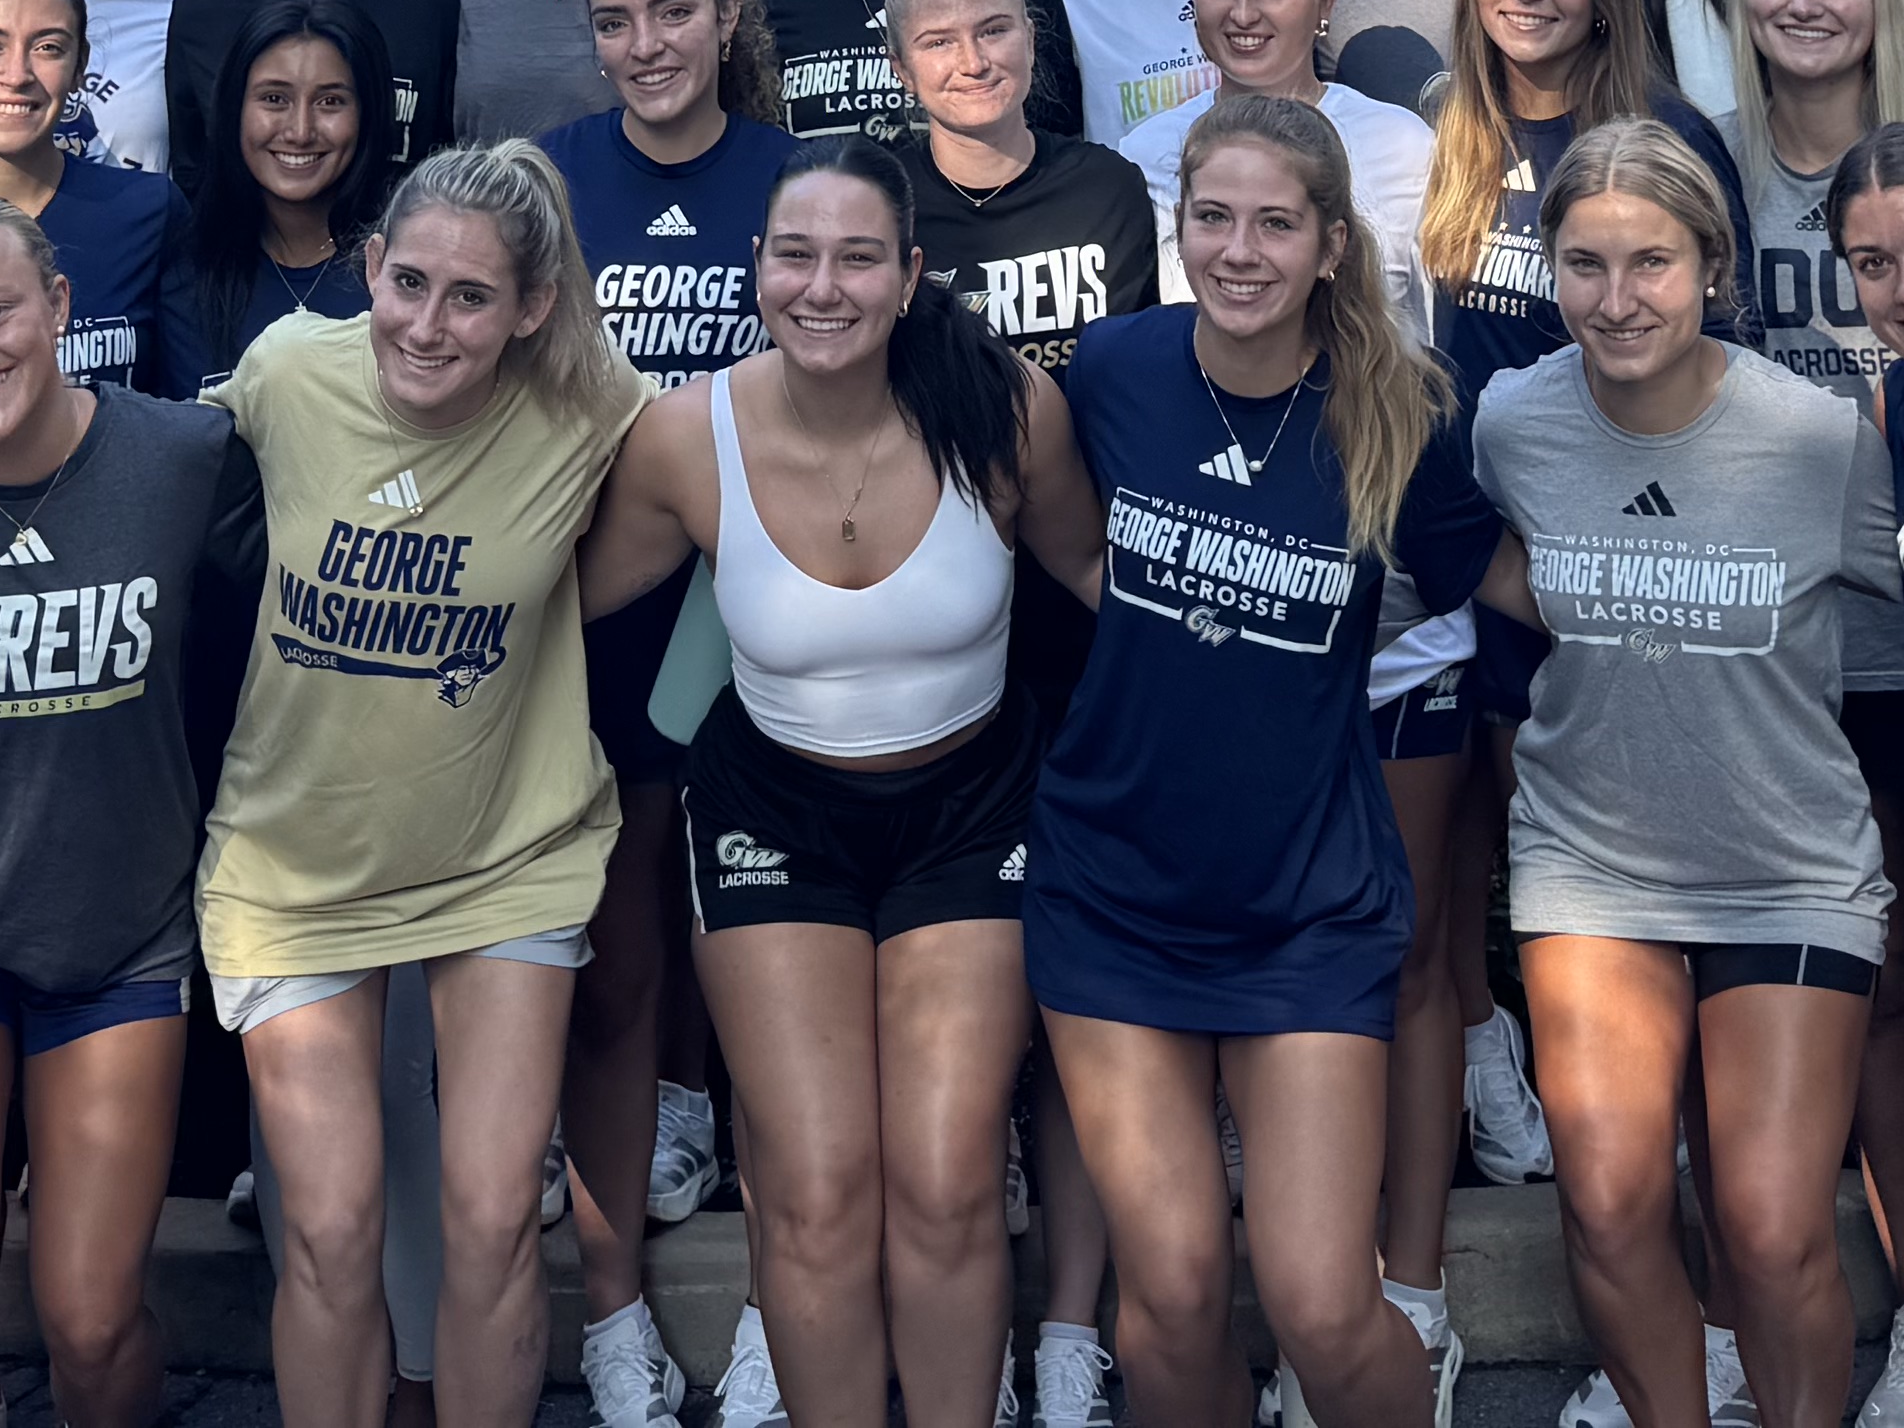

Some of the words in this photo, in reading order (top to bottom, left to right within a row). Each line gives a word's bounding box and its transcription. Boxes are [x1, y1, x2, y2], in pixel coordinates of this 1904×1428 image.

[781, 59, 853, 101] GEORGE
[1142, 56, 1194, 75] GEORGE
[646, 224, 697, 236] adidas
[595, 264, 746, 309] GEORGE
[977, 243, 1107, 337] REVS
[73, 317, 94, 329] DC
[1150, 496, 1276, 543] WASHINGTON,
[1285, 535, 1309, 550] DC
[1564, 534, 1696, 554] WASHINGTON,
[1706, 544, 1730, 556] DC
[318, 519, 473, 597] GEORGE
[1106, 497, 1188, 565] GEORGE
[1185, 526, 1356, 607] WASHINGTON
[1147, 563, 1288, 621] LACROSSE
[1530, 545, 1606, 596] GEORGE
[1612, 554, 1787, 607] WASHINGTON
[279, 562, 516, 656] WASHINGTON
[1575, 600, 1722, 631] LACROSSE
[719, 871, 789, 889] LACROSSE
